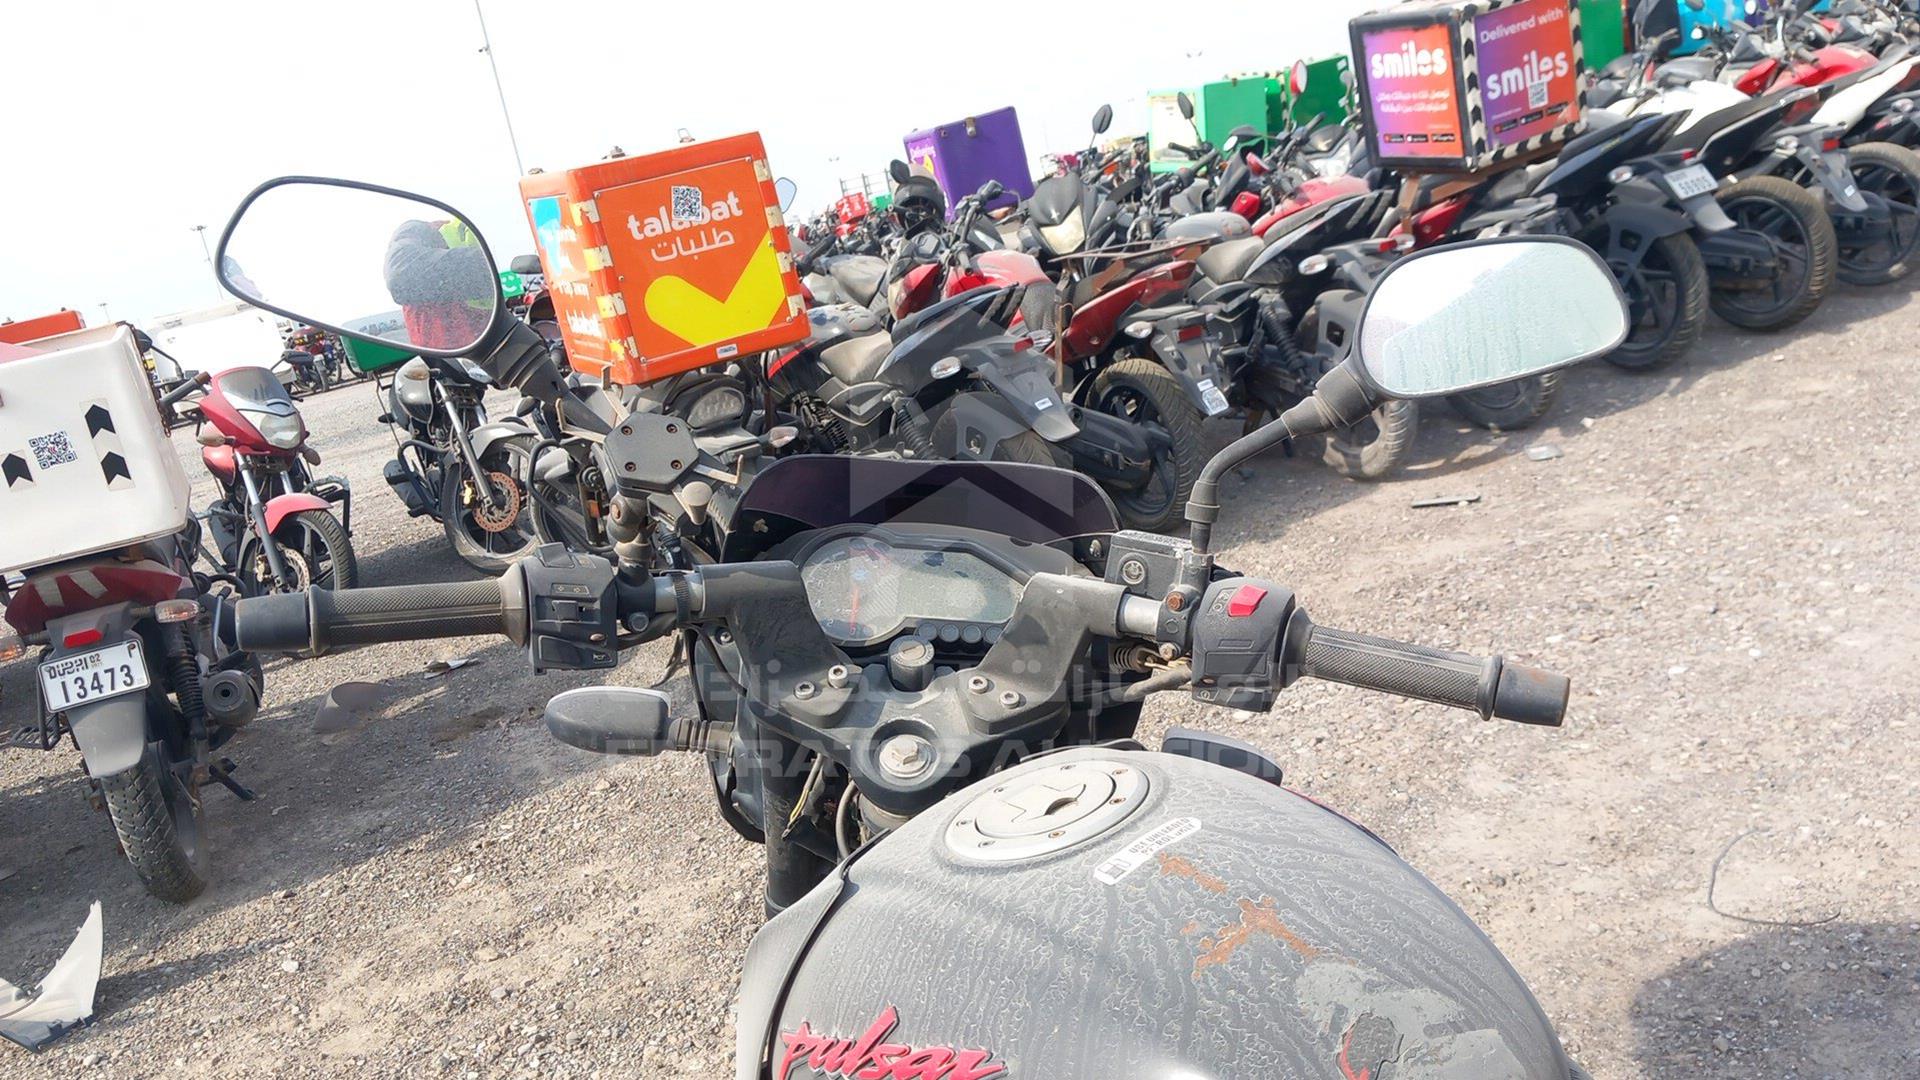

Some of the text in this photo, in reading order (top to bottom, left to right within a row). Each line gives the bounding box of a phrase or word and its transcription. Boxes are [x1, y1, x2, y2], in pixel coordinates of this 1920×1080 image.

[1480, 7, 1565, 44] Delivered with
[1371, 40, 1448, 80] smiles
[1486, 49, 1570, 101] smiles
[650, 227, 736, 263] طلبات
[61, 664, 134, 703] 13473
